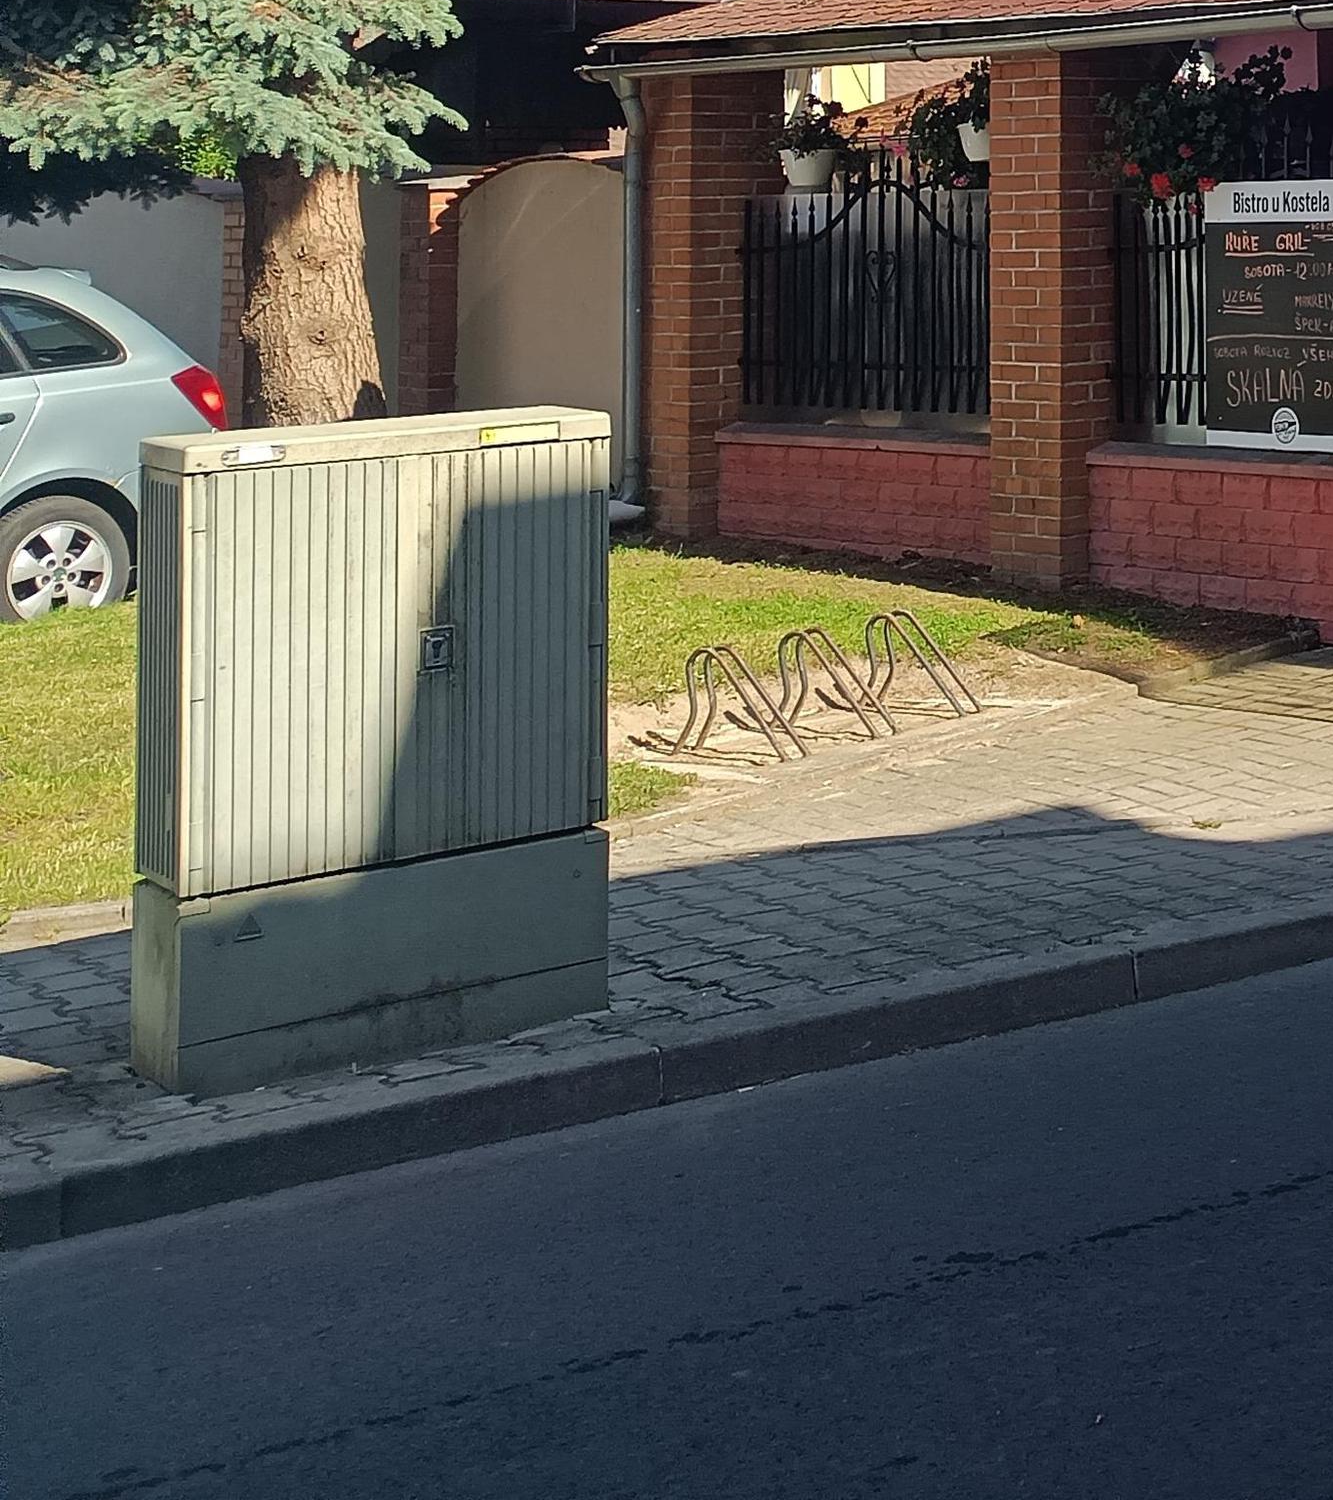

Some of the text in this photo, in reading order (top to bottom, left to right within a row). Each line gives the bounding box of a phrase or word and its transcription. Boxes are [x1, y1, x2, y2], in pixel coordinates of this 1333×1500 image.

[1233, 190, 1330, 214] Bistro u Kostela
[1226, 360, 1307, 407] SKALNÁ
